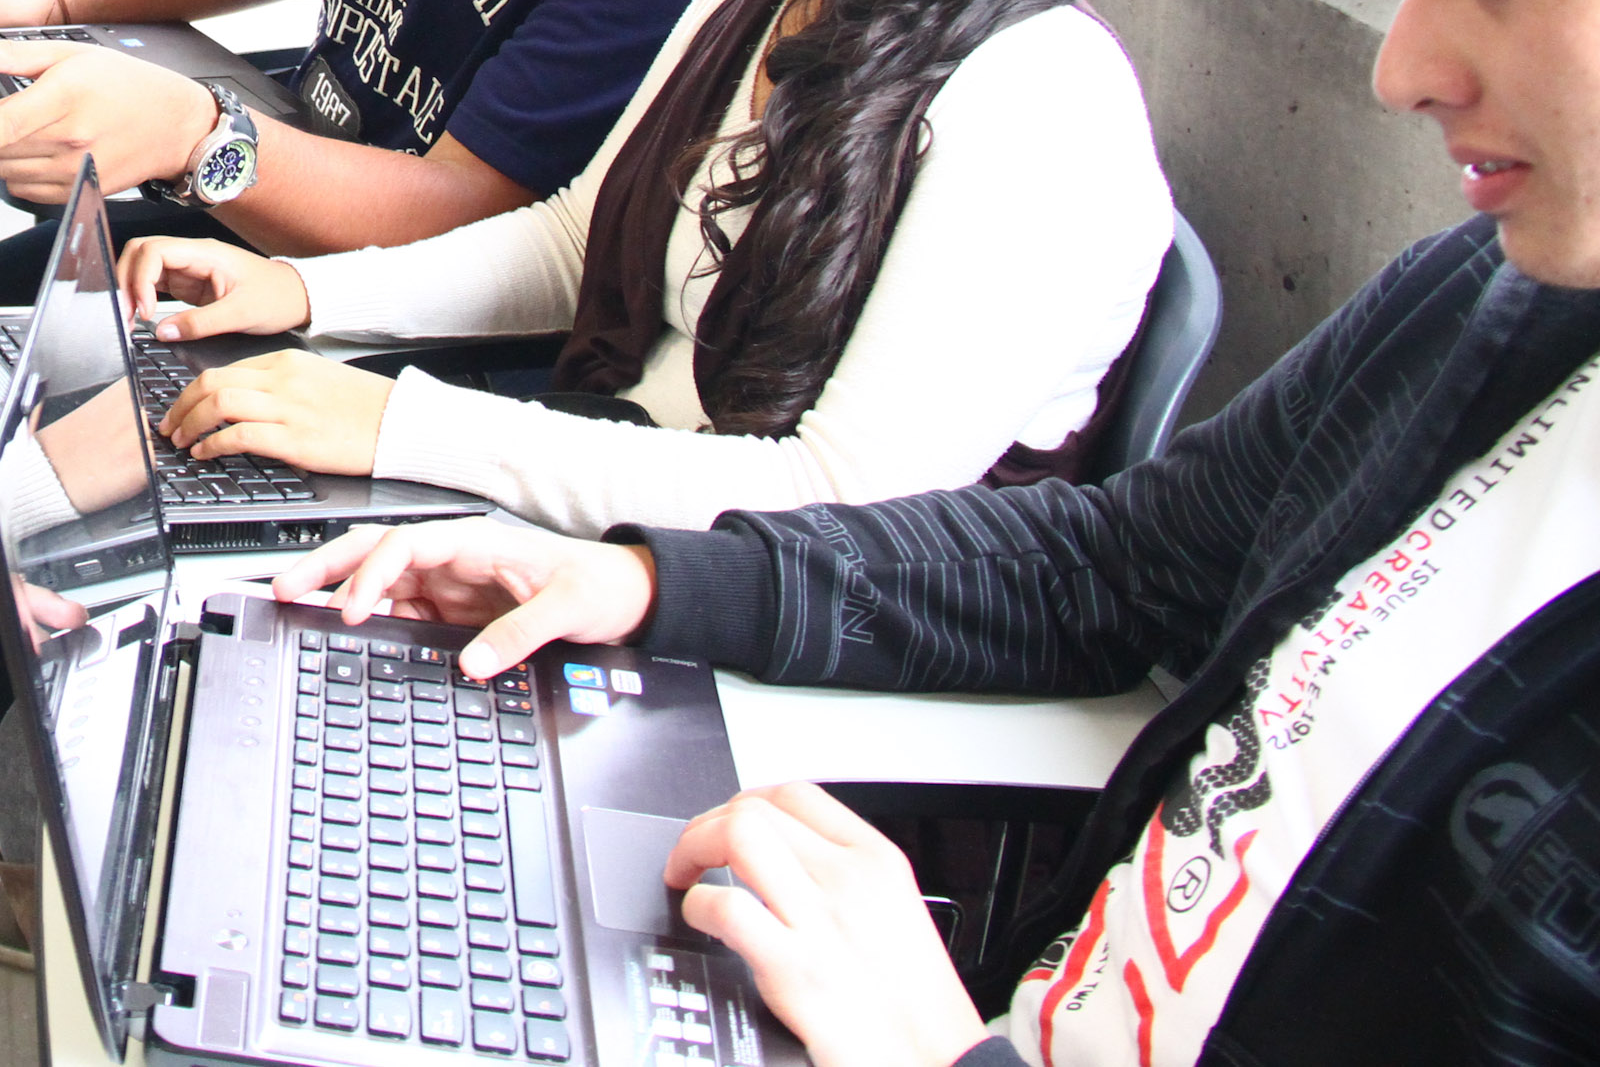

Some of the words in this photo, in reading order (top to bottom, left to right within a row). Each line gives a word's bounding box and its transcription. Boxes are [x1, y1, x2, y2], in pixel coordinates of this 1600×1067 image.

[310, 72, 352, 127] 1987
[1430, 363, 1599, 531] NLIMITED
[1257, 529, 1433, 727] CREATIVITY
[1371, 559, 1441, 622] ISSUE
